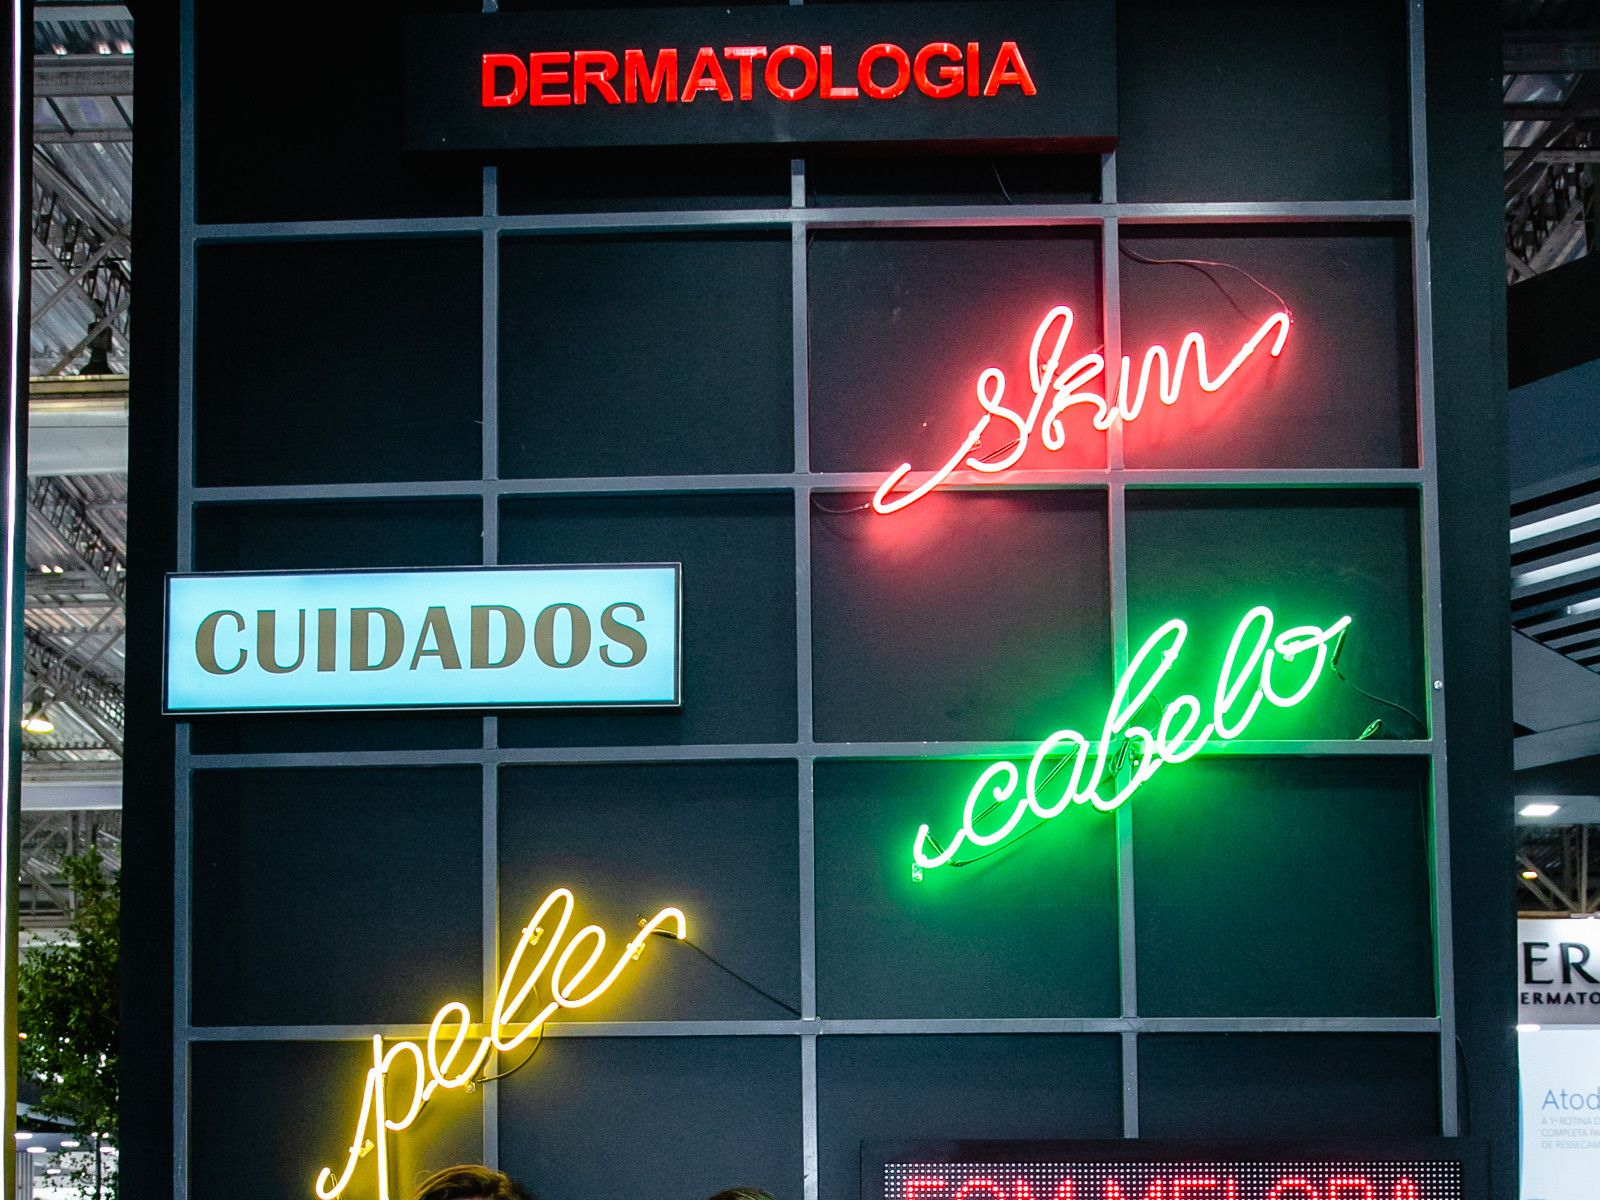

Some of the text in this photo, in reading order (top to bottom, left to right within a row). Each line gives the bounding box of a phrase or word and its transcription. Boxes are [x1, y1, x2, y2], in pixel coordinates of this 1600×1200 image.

[481, 41, 1037, 107] DERMATOLOGIA
[195, 601, 648, 675] CUIDADOS
[913, 606, 1352, 869] cabelo
